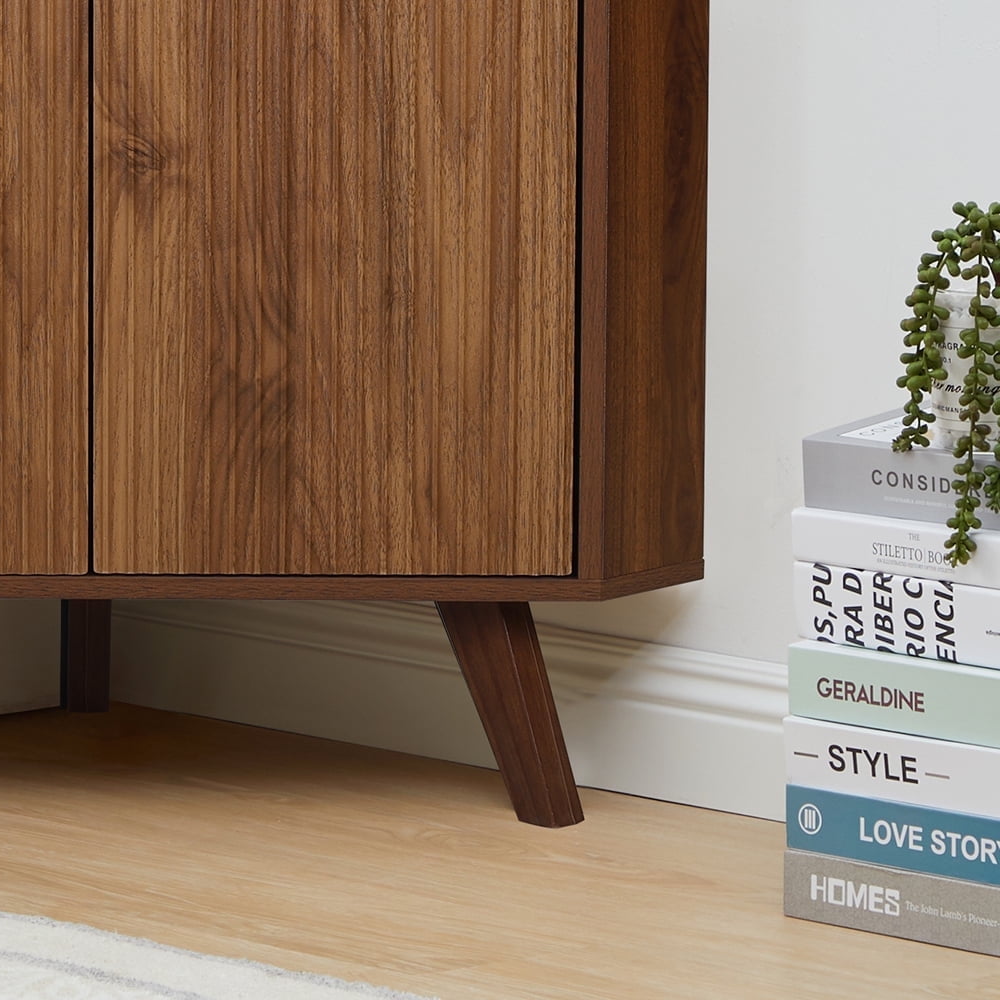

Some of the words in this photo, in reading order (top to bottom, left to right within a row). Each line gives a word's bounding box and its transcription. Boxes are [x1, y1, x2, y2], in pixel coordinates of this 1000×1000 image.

[871, 469, 996, 498] CONSID
[872, 542, 923, 561] STILETTO
[928, 550, 954, 565] BOO
[908, 532, 921, 541] THE
[873, 571, 897, 653] IBER
[816, 677, 925, 713] GERALDINE
[828, 744, 919, 785] STYLE
[859, 816, 924, 852] LOVE
[931, 829, 1000, 865] STOR
[810, 874, 900, 917] HOMES
[905, 900, 920, 912] The
[921, 904, 939, 917] John
[940, 907, 967, 922] Lamb's
